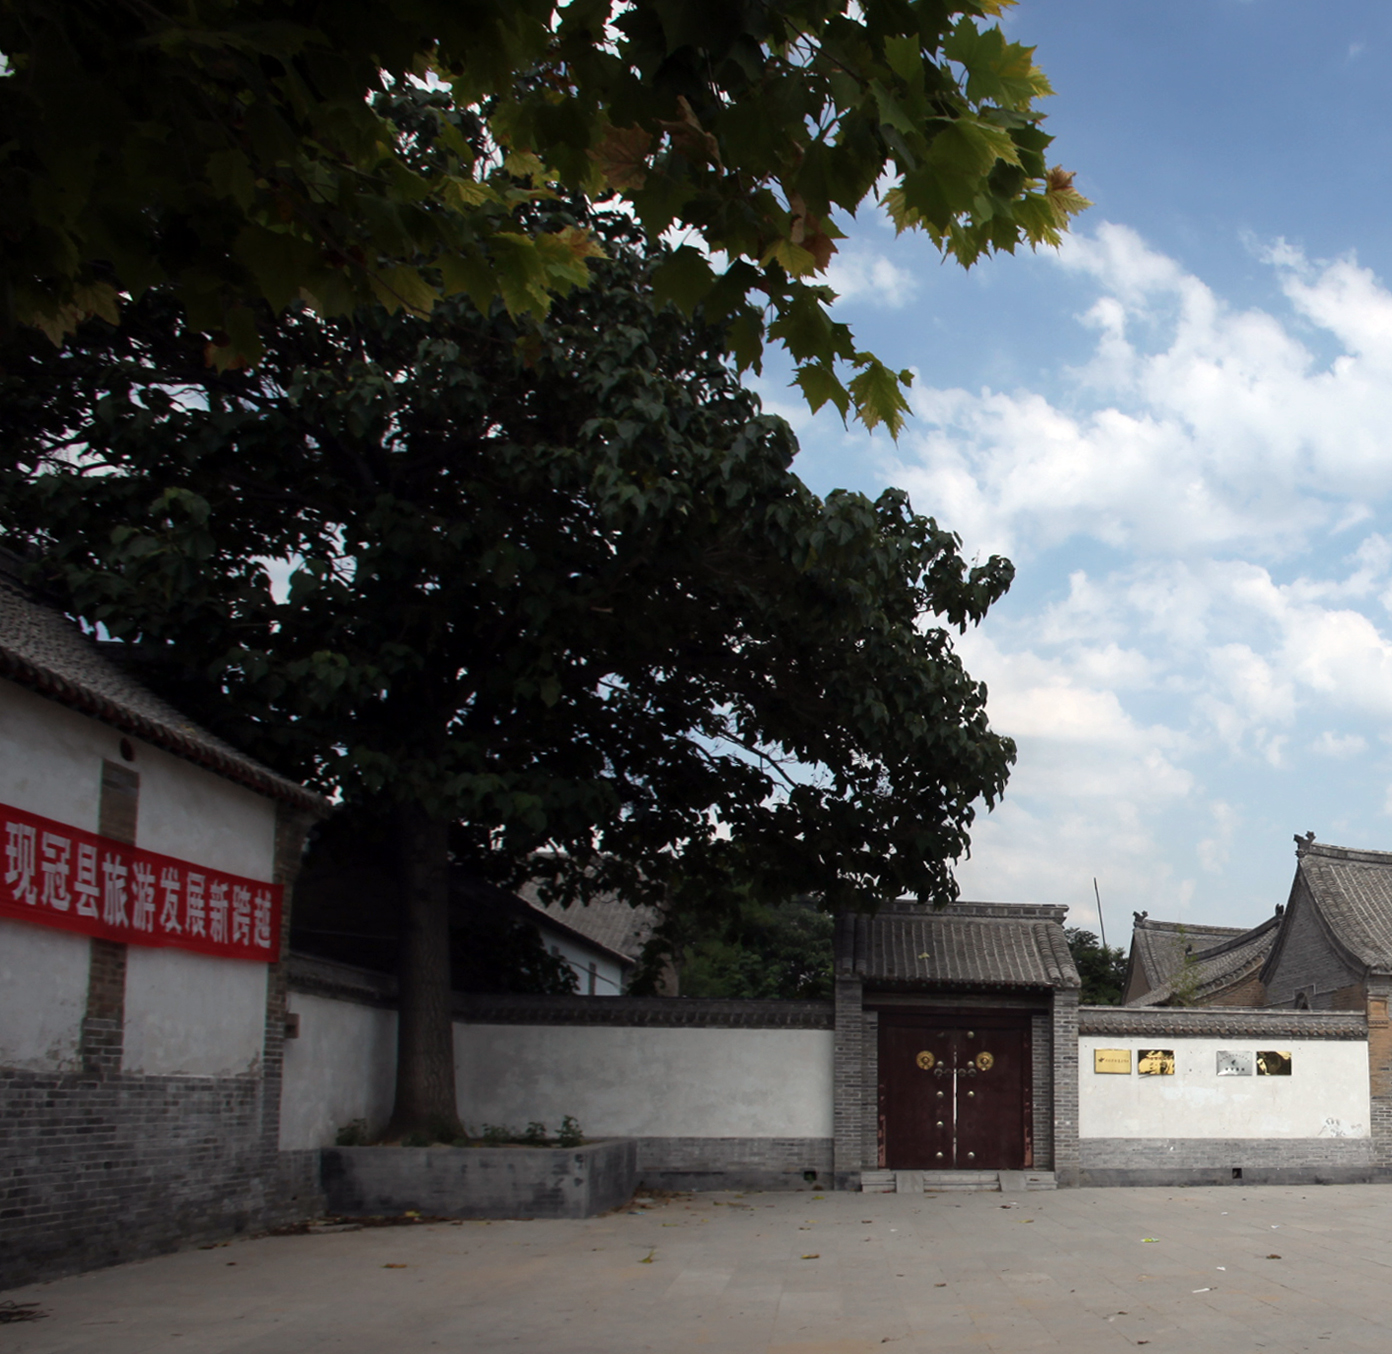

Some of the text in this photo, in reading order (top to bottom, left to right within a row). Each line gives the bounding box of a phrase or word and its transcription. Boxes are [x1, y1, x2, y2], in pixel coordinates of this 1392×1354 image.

[4, 821, 272, 948] 现冠县旅游发展新跨越
